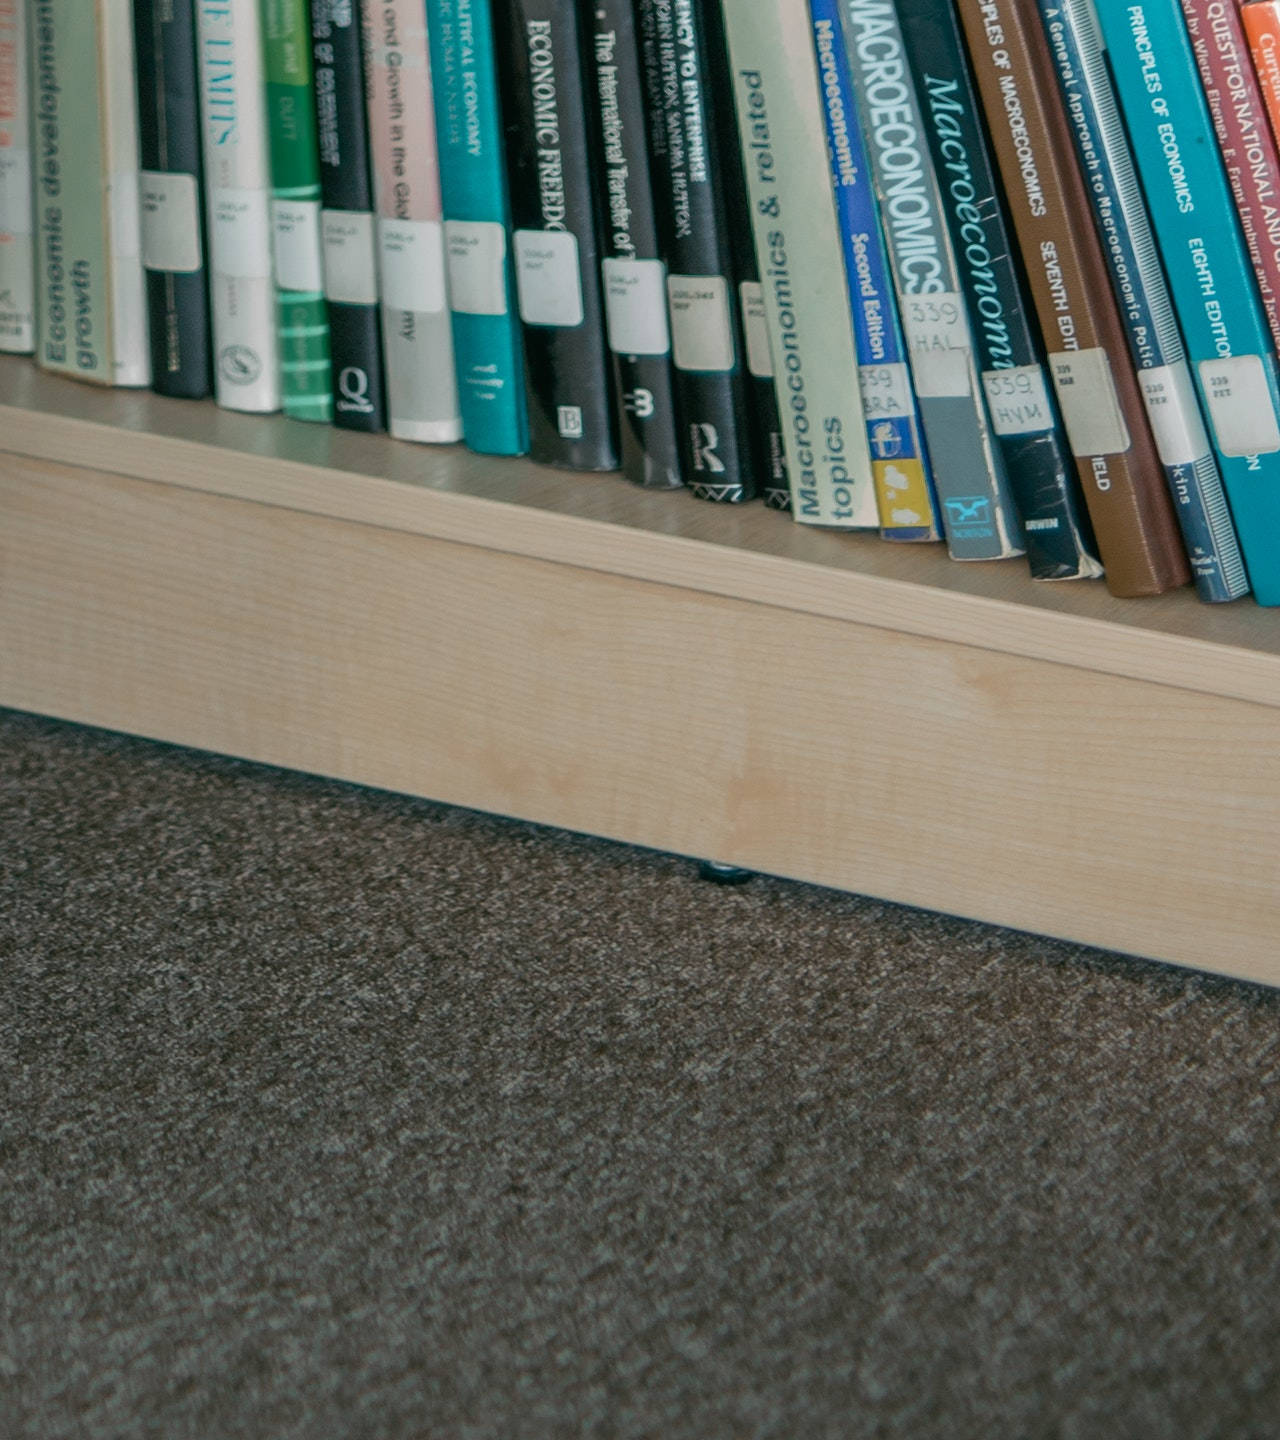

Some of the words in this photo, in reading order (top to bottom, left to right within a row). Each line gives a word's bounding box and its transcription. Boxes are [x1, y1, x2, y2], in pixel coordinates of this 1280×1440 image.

[1126, 4, 1164, 95] PRINCIPLES
[741, 69, 776, 186] related
[1150, 97, 1168, 120] OF
[760, 194, 782, 218] &
[1156, 120, 1196, 213] ECONOMICS
[42, 206, 67, 363] Economic
[71, 258, 95, 370] growth
[761, 230, 824, 516] Macroeconomics
[823, 415, 854, 521] topics
